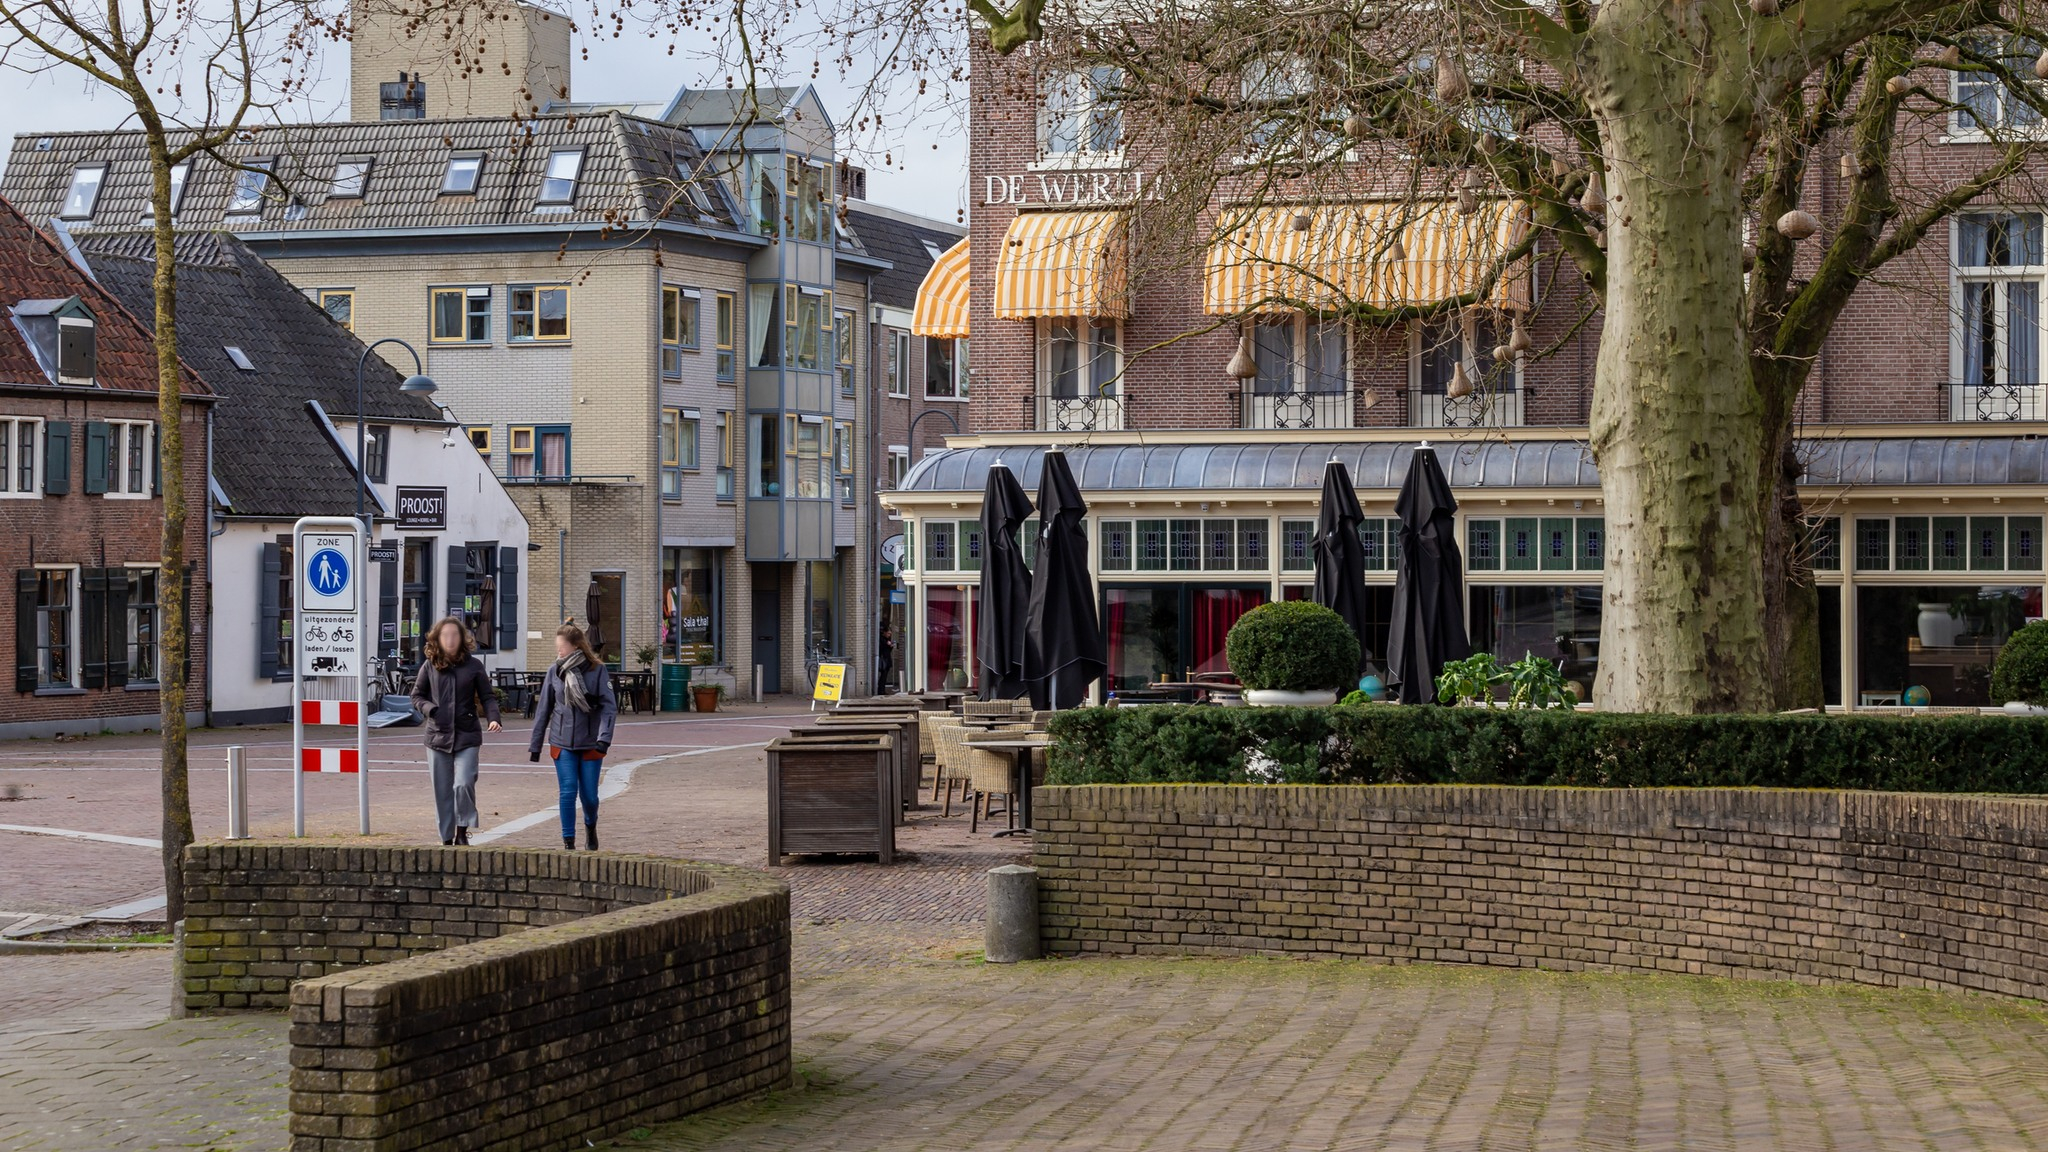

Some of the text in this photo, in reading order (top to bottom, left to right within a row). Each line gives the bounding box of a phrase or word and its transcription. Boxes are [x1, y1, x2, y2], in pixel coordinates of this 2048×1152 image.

[984, 174, 1027, 204] DE
[400, 497, 443, 514] PROOST!
[317, 538, 340, 546] ZONE
[304, 616, 354, 624] uitgezonderd
[683, 616, 696, 628] Sala
